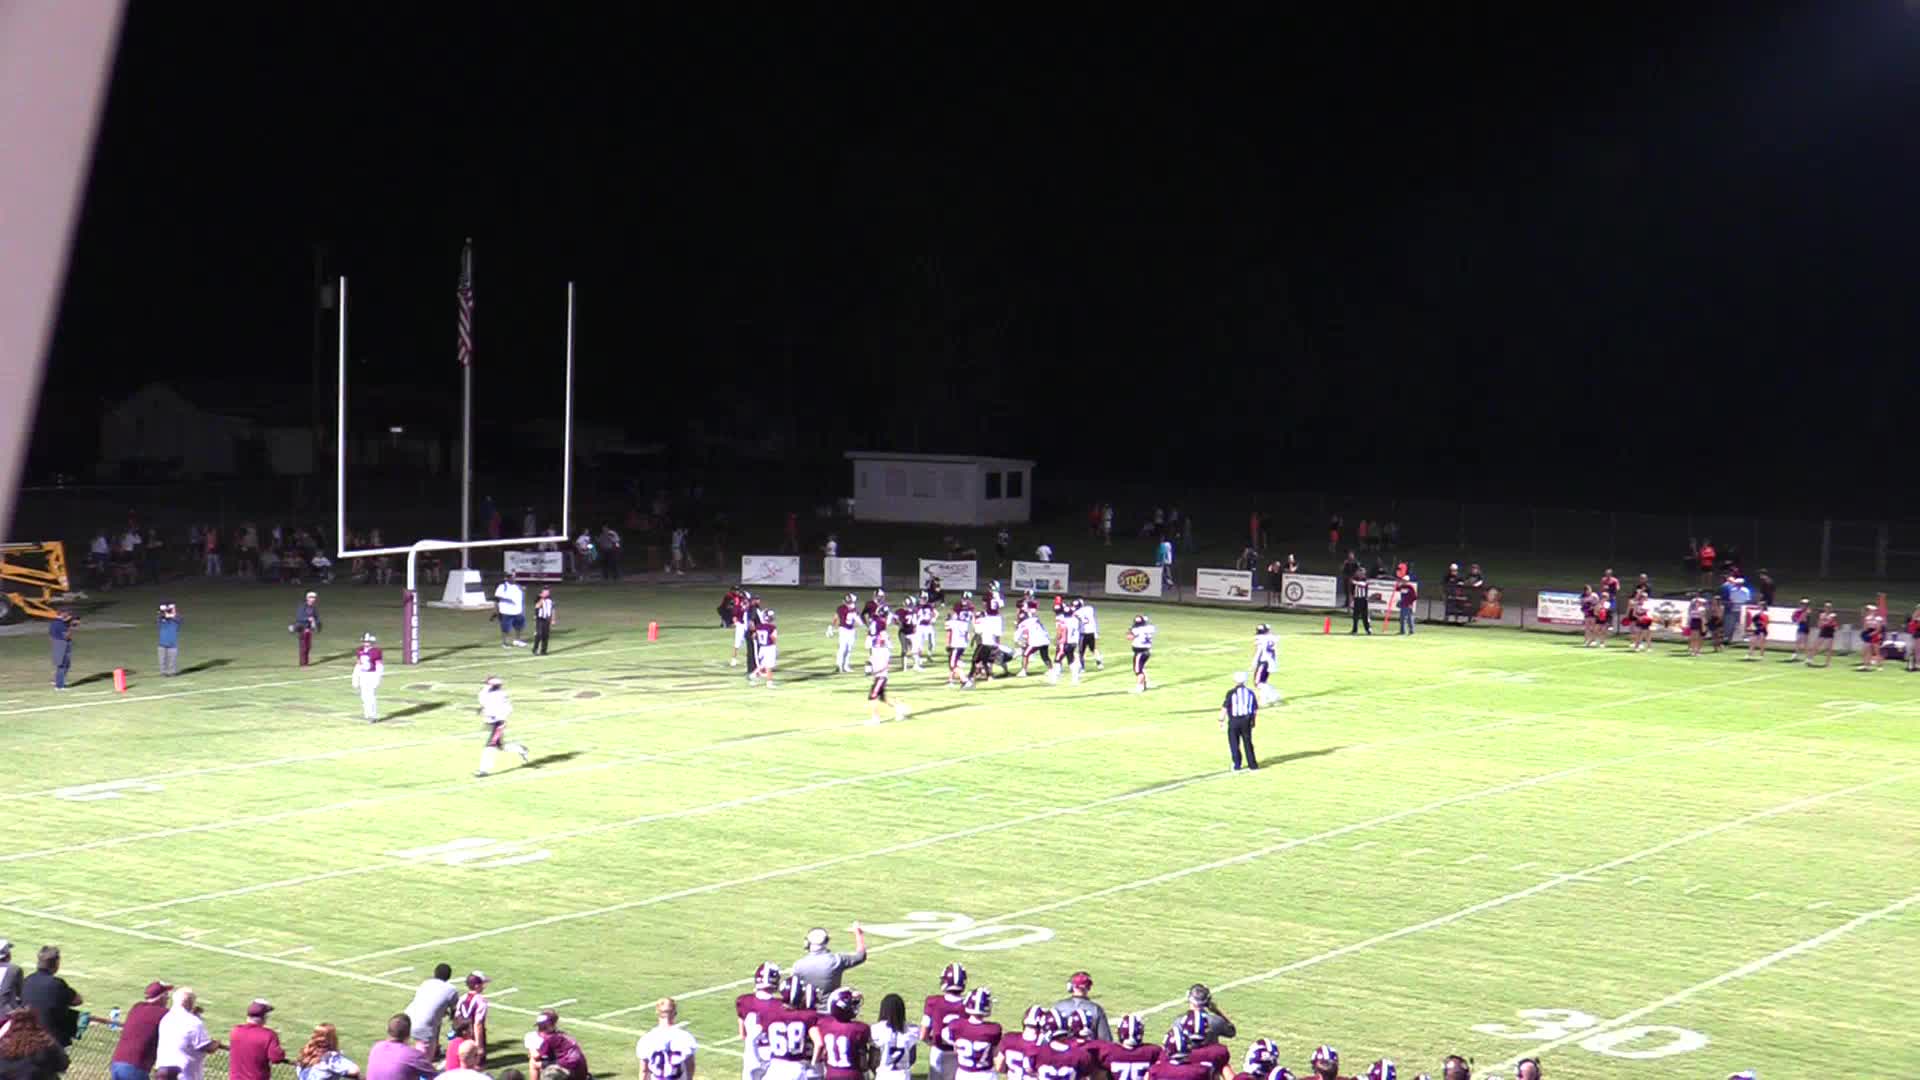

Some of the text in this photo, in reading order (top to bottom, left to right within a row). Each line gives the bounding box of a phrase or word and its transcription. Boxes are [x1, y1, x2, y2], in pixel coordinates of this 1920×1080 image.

[846, 910, 1055, 950] 20
[824, 1033, 852, 1068] 11
[1471, 1008, 1710, 1059] 30
[953, 1038, 992, 1068] 27
